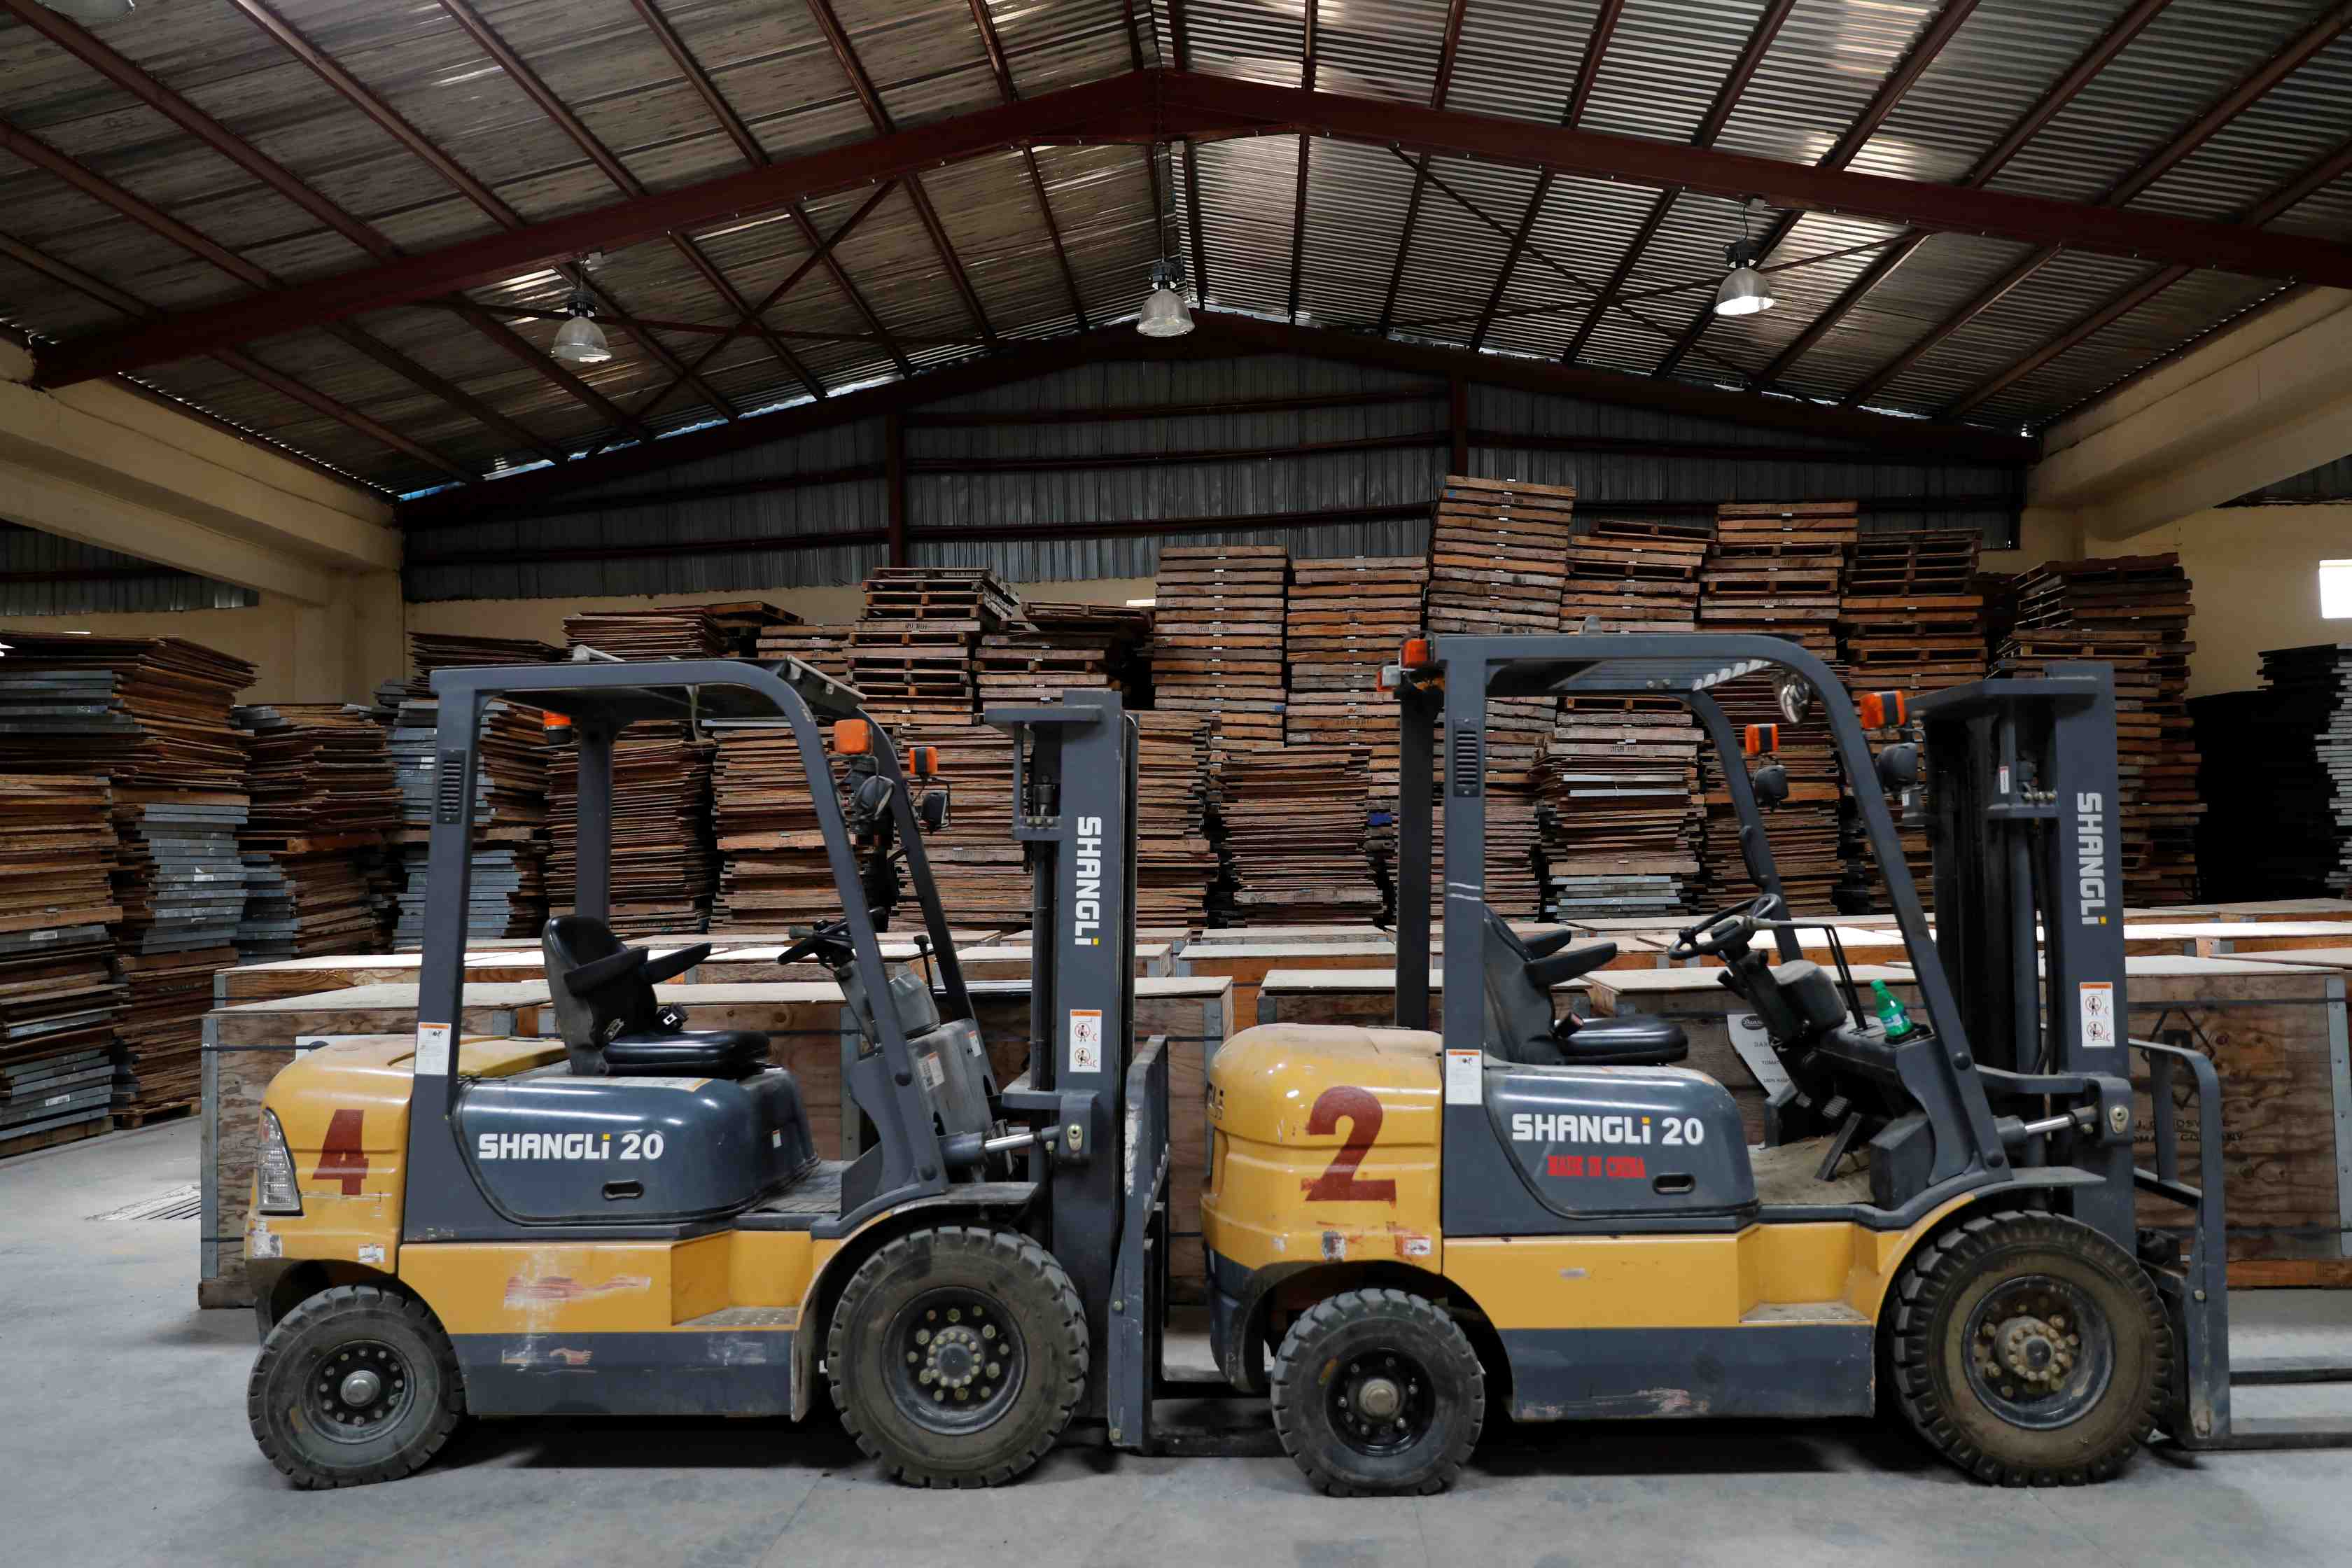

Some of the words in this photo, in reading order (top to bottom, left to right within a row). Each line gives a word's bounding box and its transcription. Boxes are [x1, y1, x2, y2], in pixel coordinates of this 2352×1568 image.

[1306, 1086, 1396, 1202] 2
[1661, 1117, 1704, 1146] 20
[312, 1109, 369, 1195] 4
[620, 1133, 664, 1160] 20
[1547, 1155, 1583, 1177] MADE
[1587, 1156, 1602, 1177] IN
[1606, 1156, 1647, 1178] CHINA
